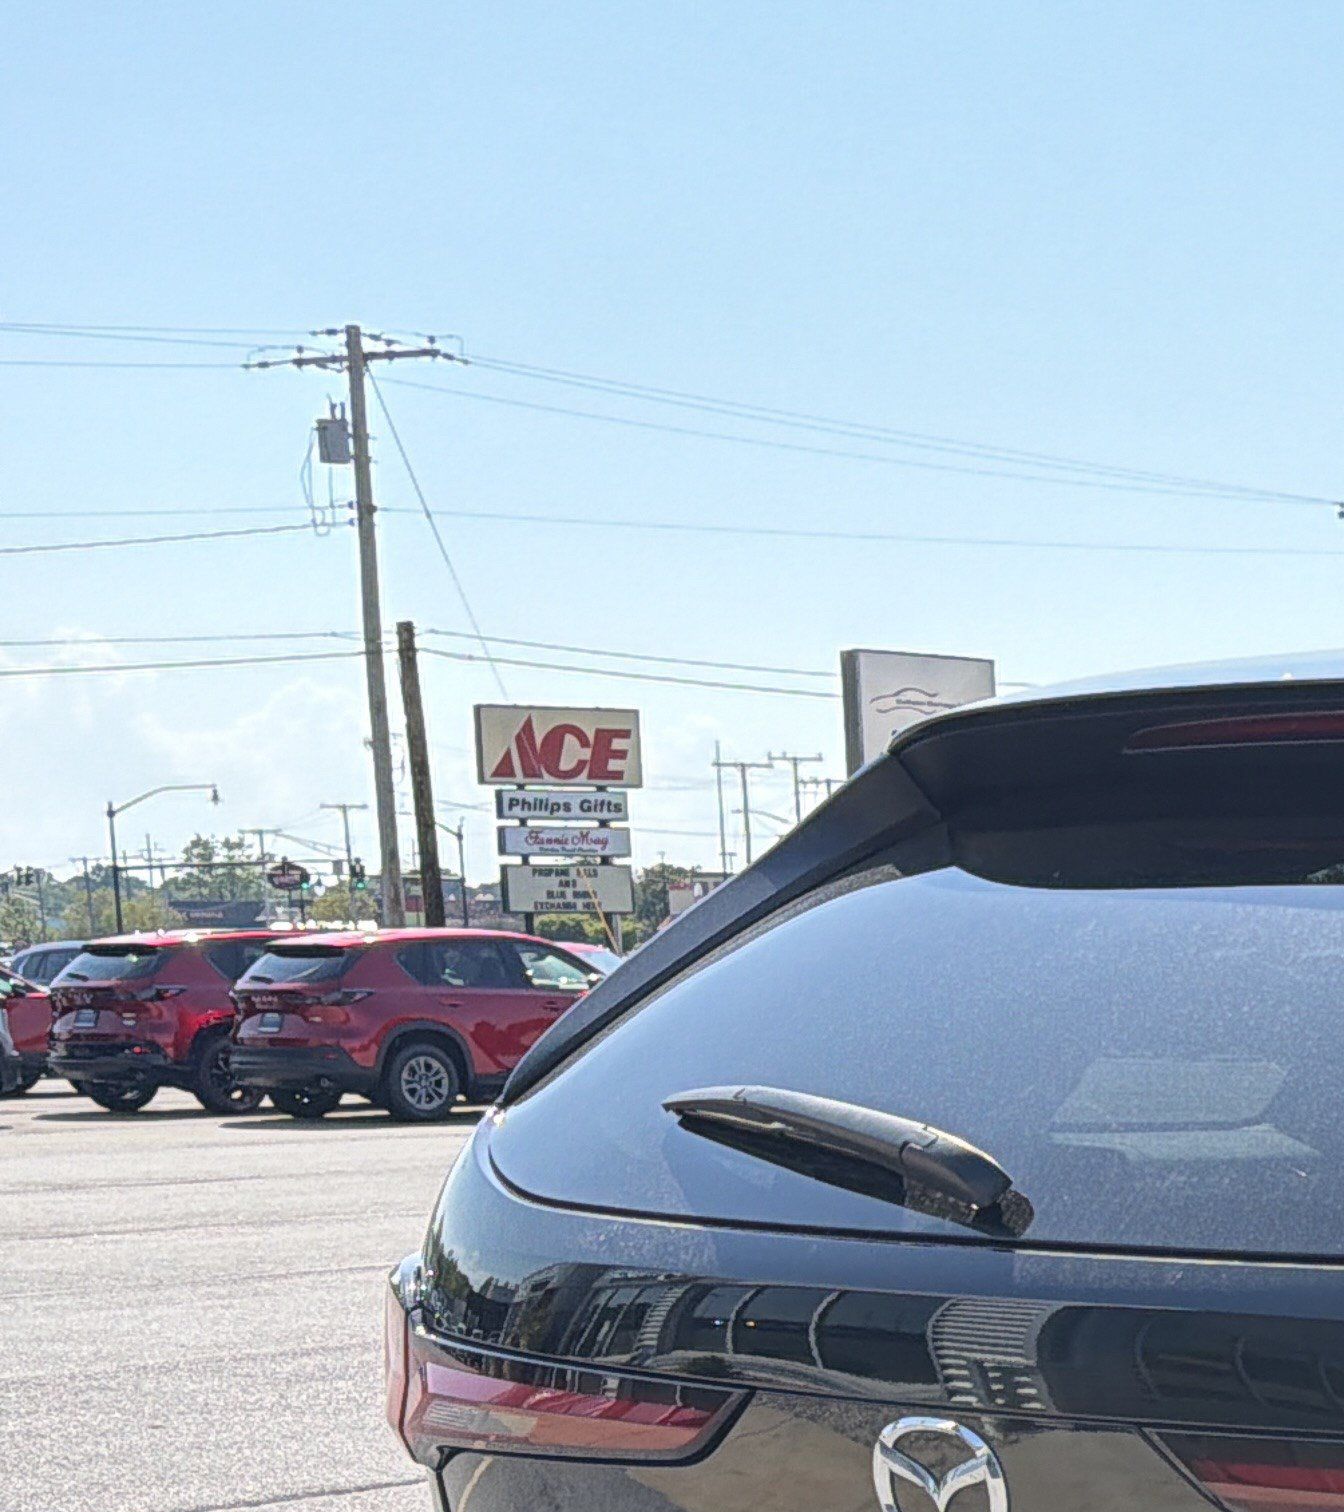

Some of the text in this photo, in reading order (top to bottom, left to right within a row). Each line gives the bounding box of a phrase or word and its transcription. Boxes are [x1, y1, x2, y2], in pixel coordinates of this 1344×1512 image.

[490, 713, 631, 781] ACE
[508, 797, 622, 815] Philips Gifts
[525, 829, 570, 846] Fannie
